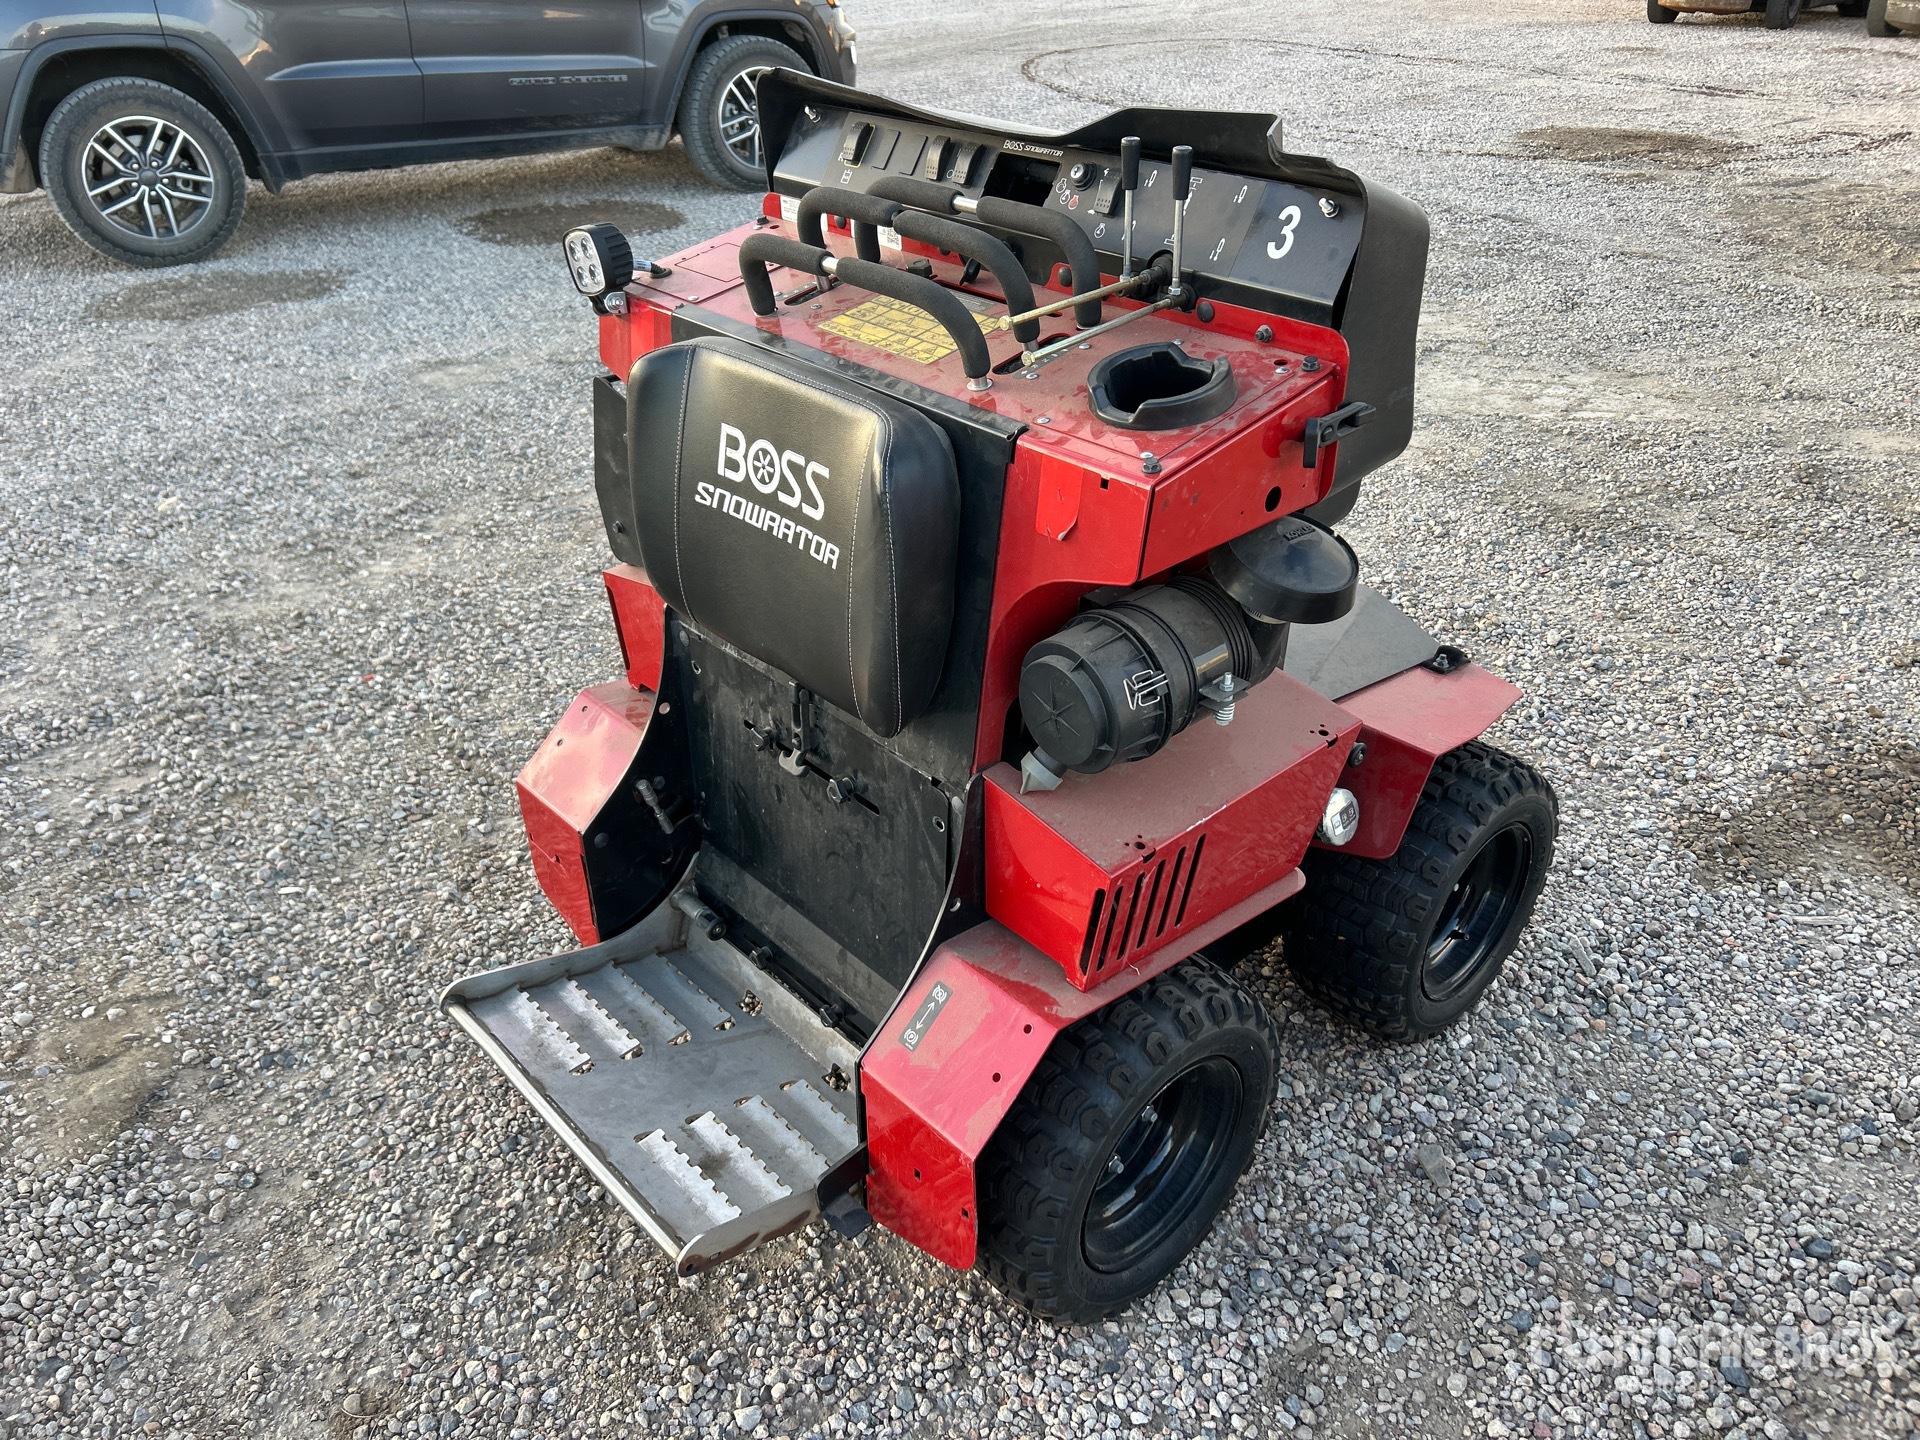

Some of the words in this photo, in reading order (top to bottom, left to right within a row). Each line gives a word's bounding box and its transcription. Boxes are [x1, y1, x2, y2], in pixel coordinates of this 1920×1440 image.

[1003, 139, 1025, 151] BOSS
[1265, 204, 1302, 261] 3
[717, 422, 830, 522] BOSS
[694, 481, 840, 570] SNOWRATOR
